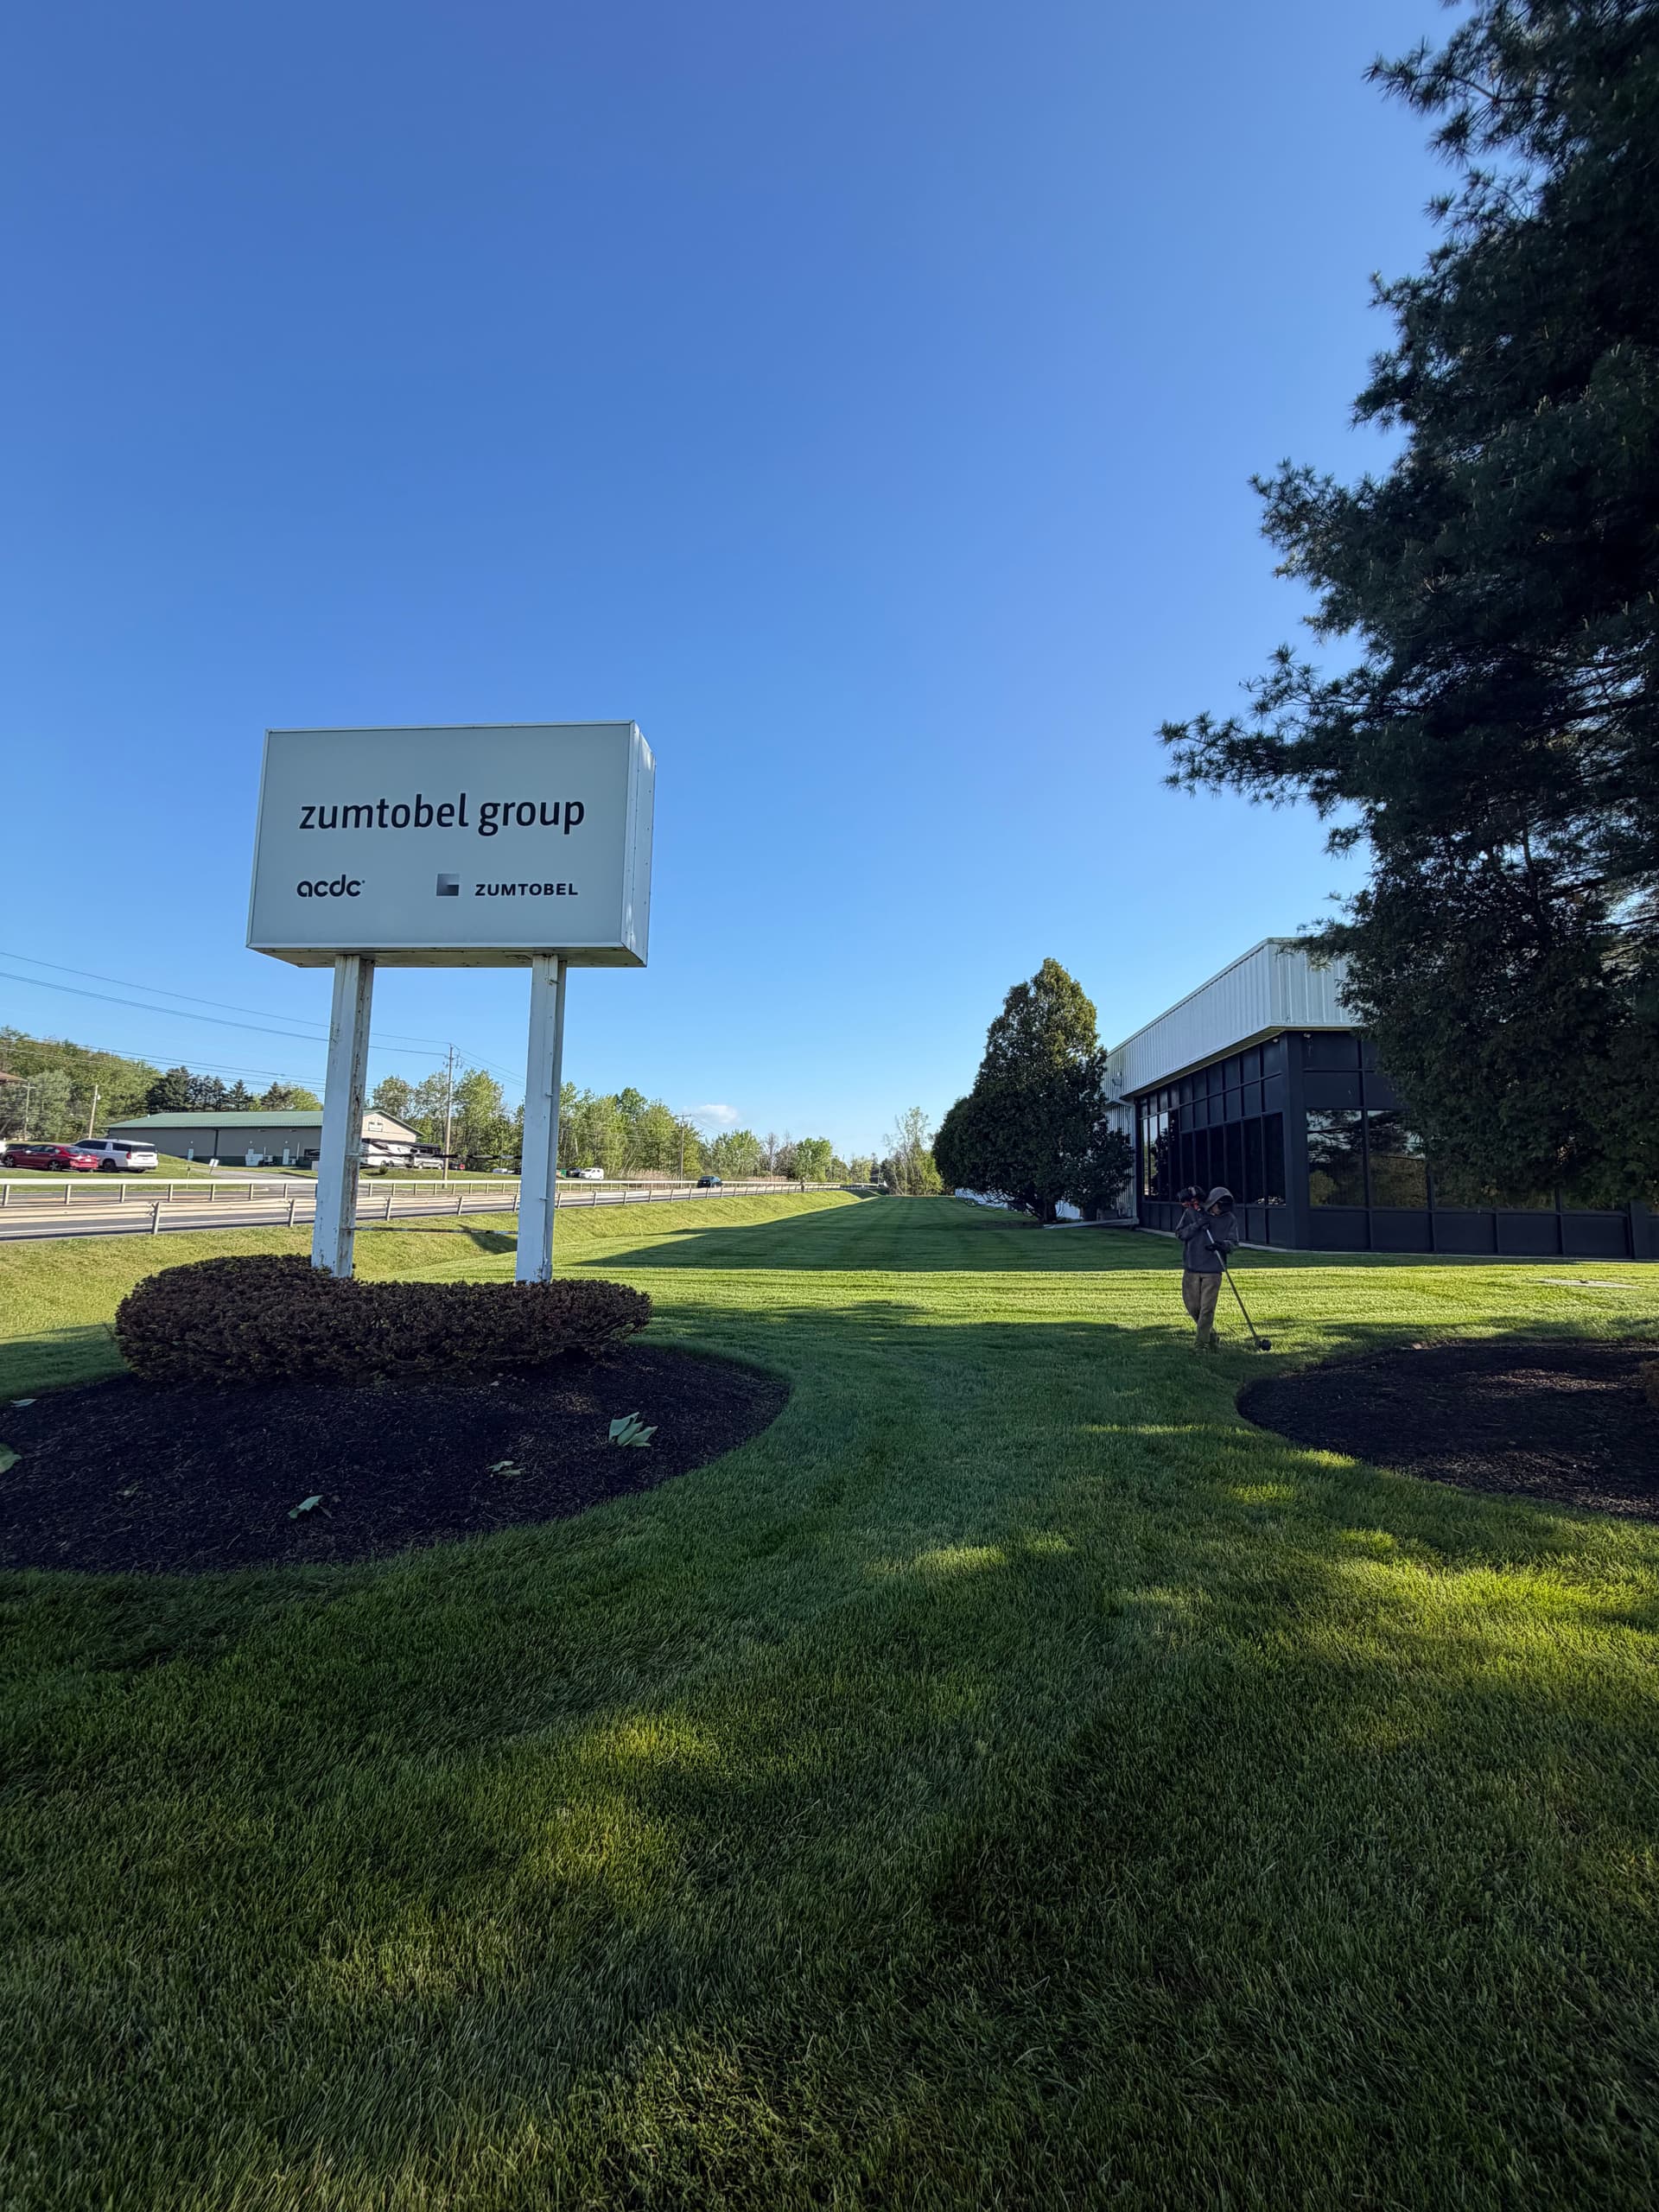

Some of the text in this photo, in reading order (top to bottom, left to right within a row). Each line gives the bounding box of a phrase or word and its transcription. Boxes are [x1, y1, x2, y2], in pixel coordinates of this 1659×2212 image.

[298, 792, 586, 837] zumtobel group
[296, 874, 363, 898] acdc
[474, 882, 580, 897] ZUMTOBEL
